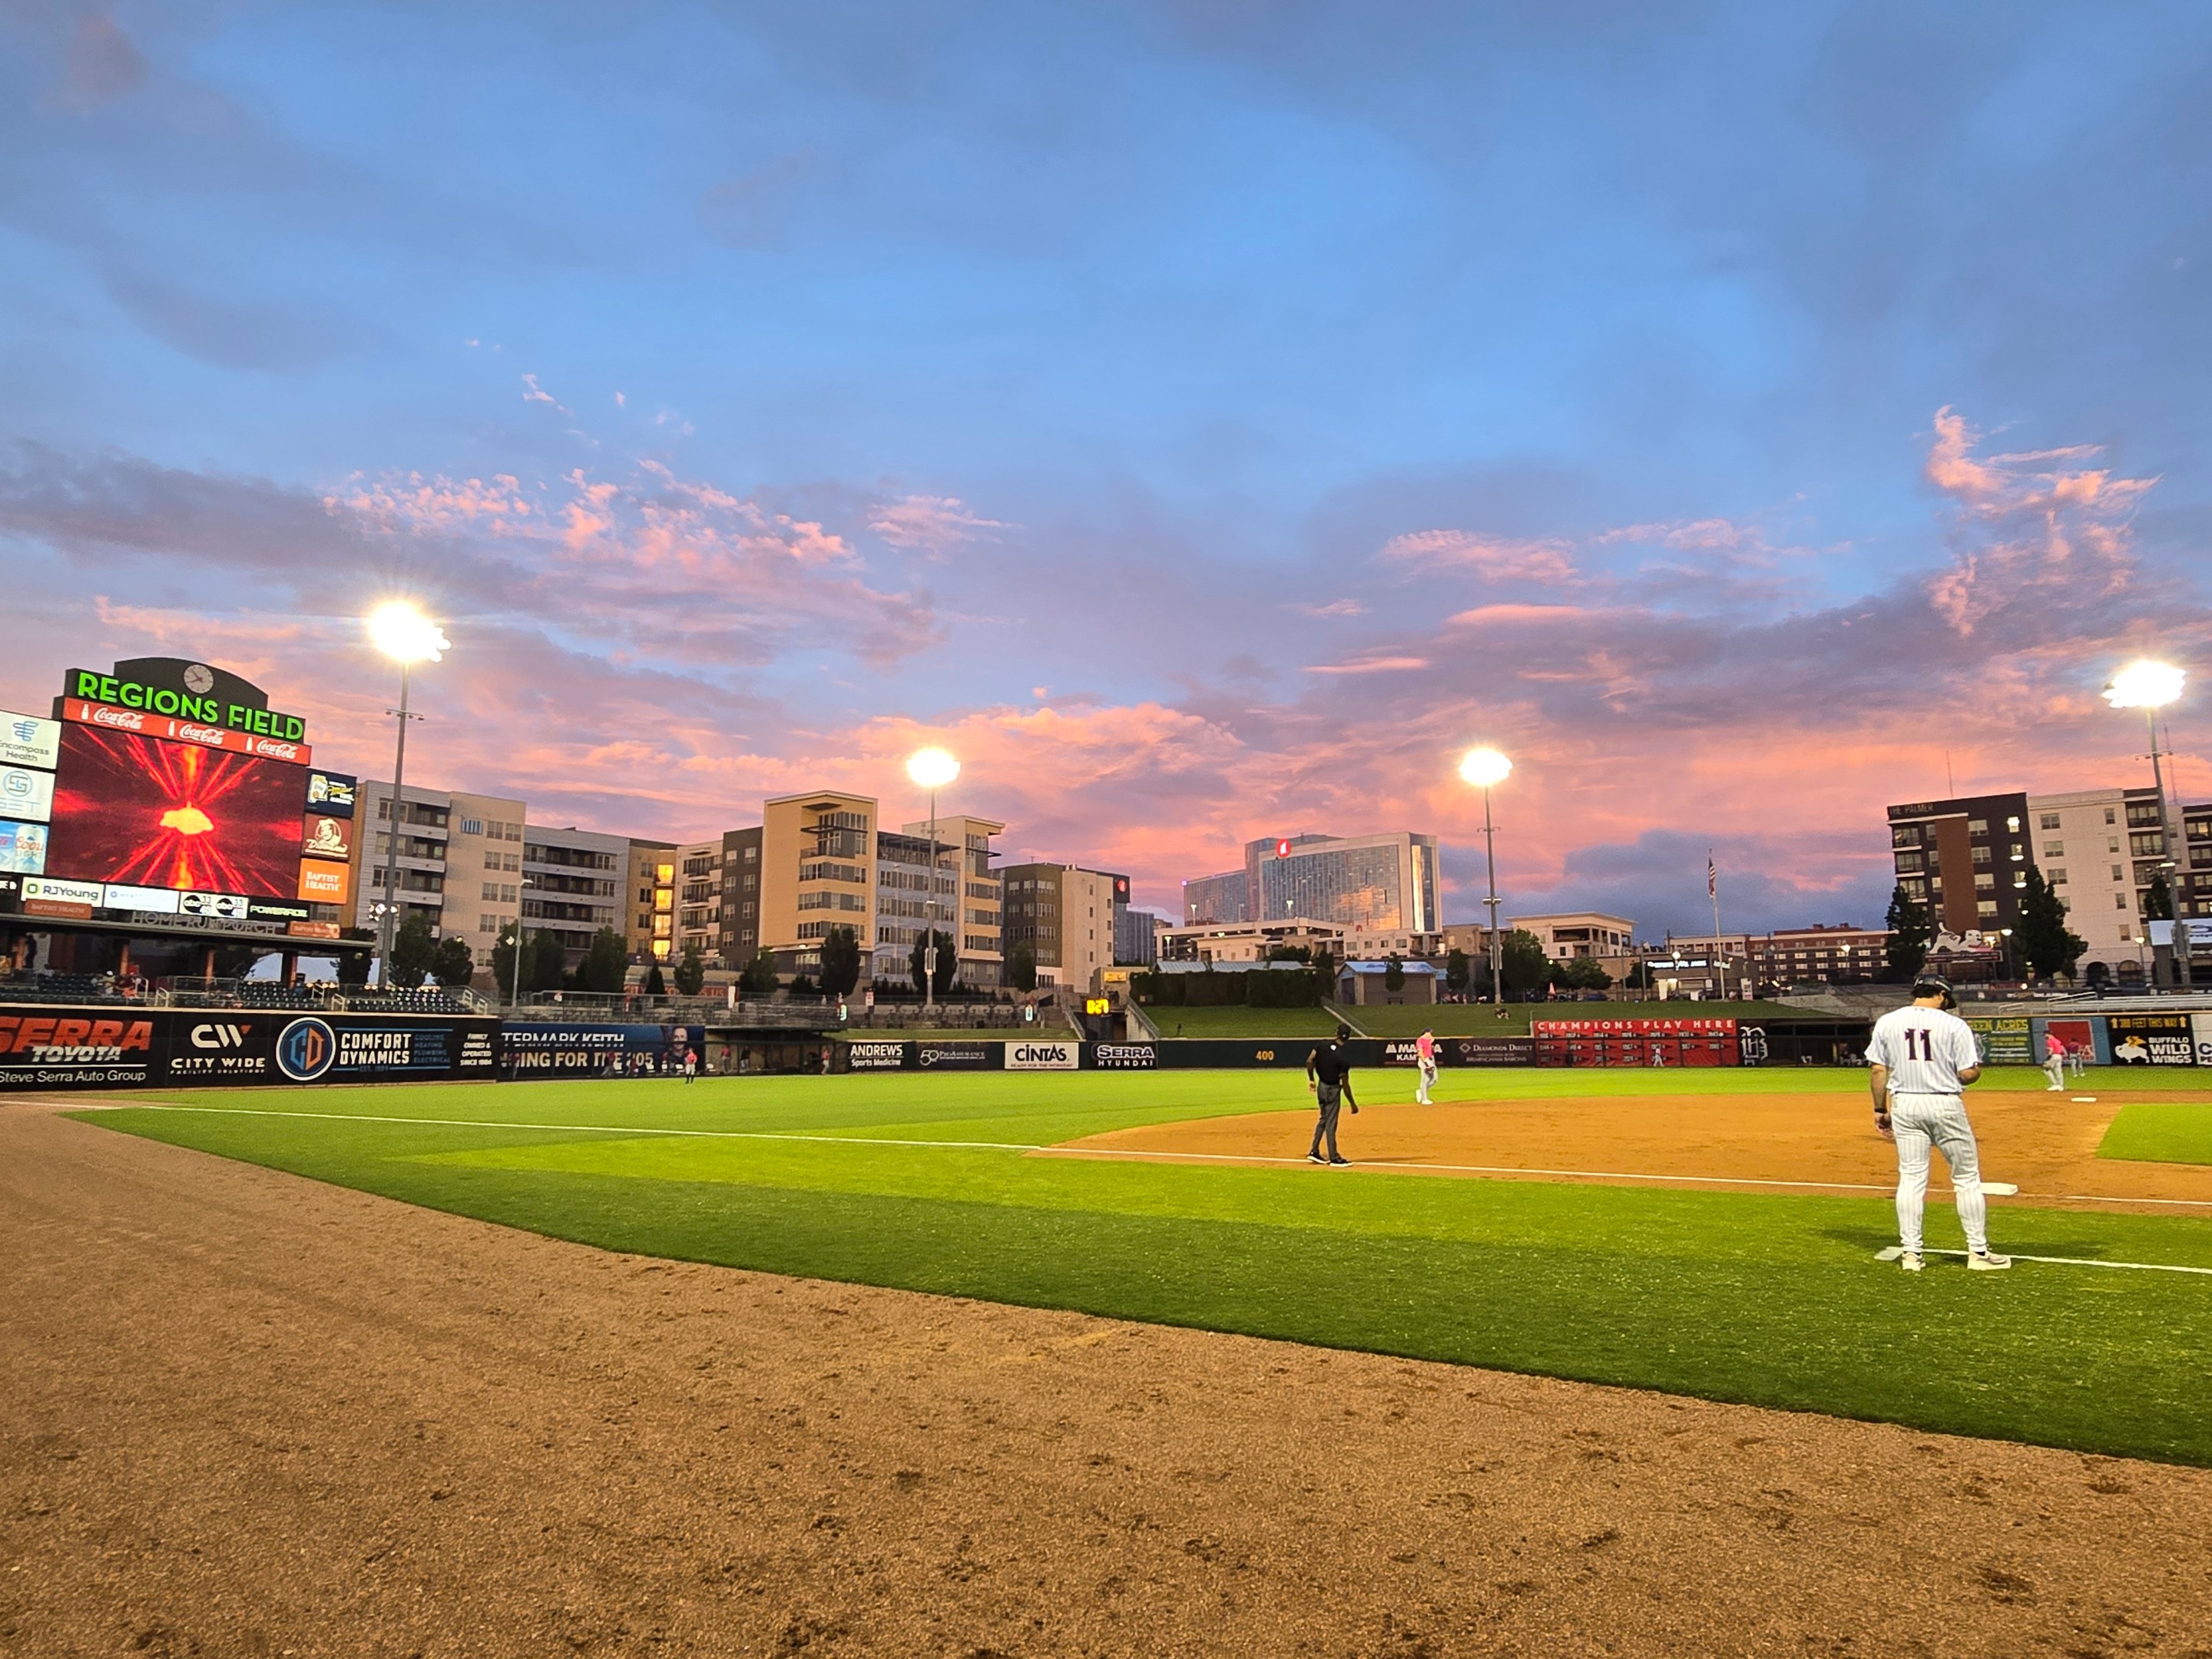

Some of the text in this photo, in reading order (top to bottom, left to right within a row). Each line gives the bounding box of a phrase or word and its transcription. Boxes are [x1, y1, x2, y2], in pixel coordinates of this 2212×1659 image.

[78, 672, 303, 740] REGIONS FIELD
[6, 750, 38, 762] Health
[306, 871, 339, 882] BAPTIST
[306, 879, 339, 891] HEALTH
[132, 910, 184, 928] HOME
[223, 918, 276, 935] PORCH
[1538, 1019, 1733, 1030] CHAMPIONS PLAY HERE
[1995, 1018, 2028, 1031] ACRES
[341, 1033, 412, 1049] COMFORT
[1904, 1028, 1934, 1061] 11
[31, 1045, 122, 1061] TOYOTA
[850, 1045, 903, 1057] ANDREWS
[1097, 1045, 1155, 1058] SERRA
[1256, 1050, 1274, 1061] 400
[2149, 1044, 2190, 1055] WILD
[171, 1058, 266, 1068] CITY WIDE
[339, 1050, 410, 1065] DYNAMICS
[555, 1052, 588, 1068] FOR
[851, 1058, 873, 1068] Sports
[2151, 1055, 2192, 1063] WINGS
[37, 1070, 73, 1083] Serra
[75, 1070, 105, 1082] Auto
[108, 1069, 146, 1082] Group
